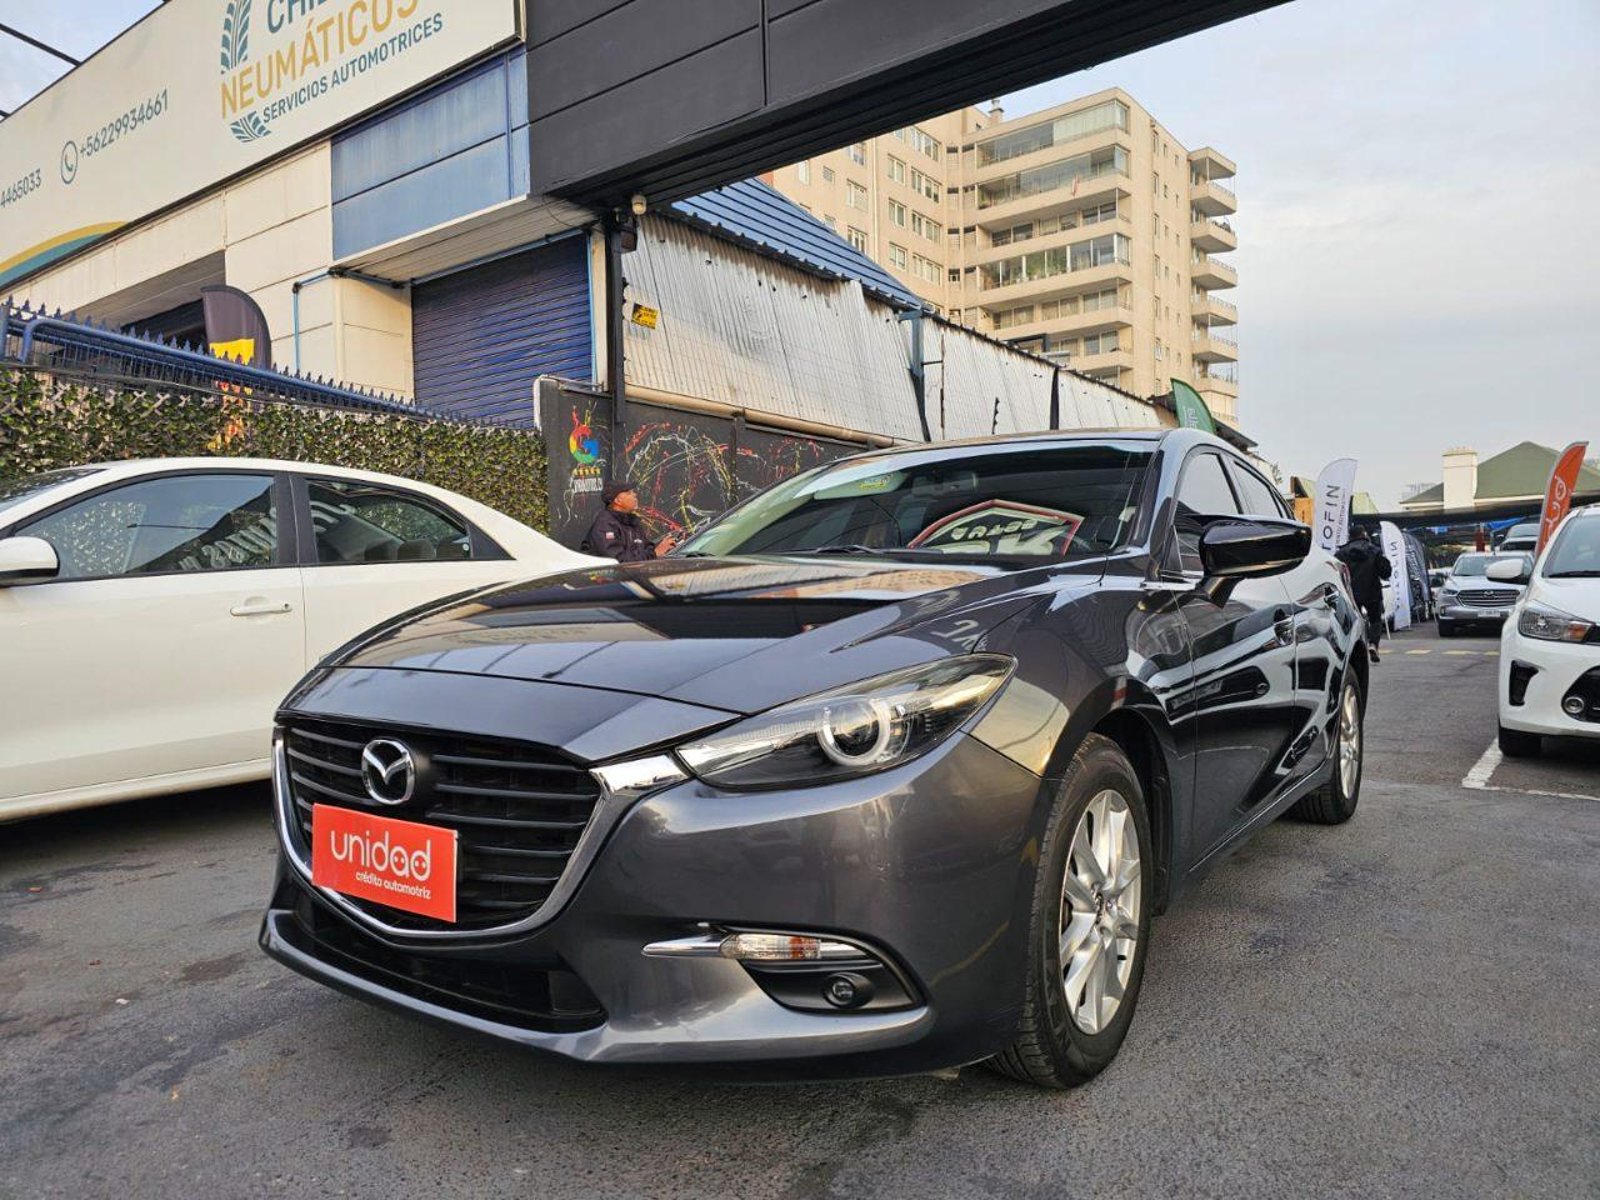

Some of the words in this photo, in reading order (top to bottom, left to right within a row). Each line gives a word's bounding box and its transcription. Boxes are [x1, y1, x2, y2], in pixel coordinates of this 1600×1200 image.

[262, 76, 328, 124] SERVICIOS
[331, 12, 443, 88] AUTOMOTRICES
[80, 88, 168, 158] +56229934661
[331, 830, 431, 881] unidad
[355, 871, 382, 887] crédito
[384, 880, 432, 899] automotriz
